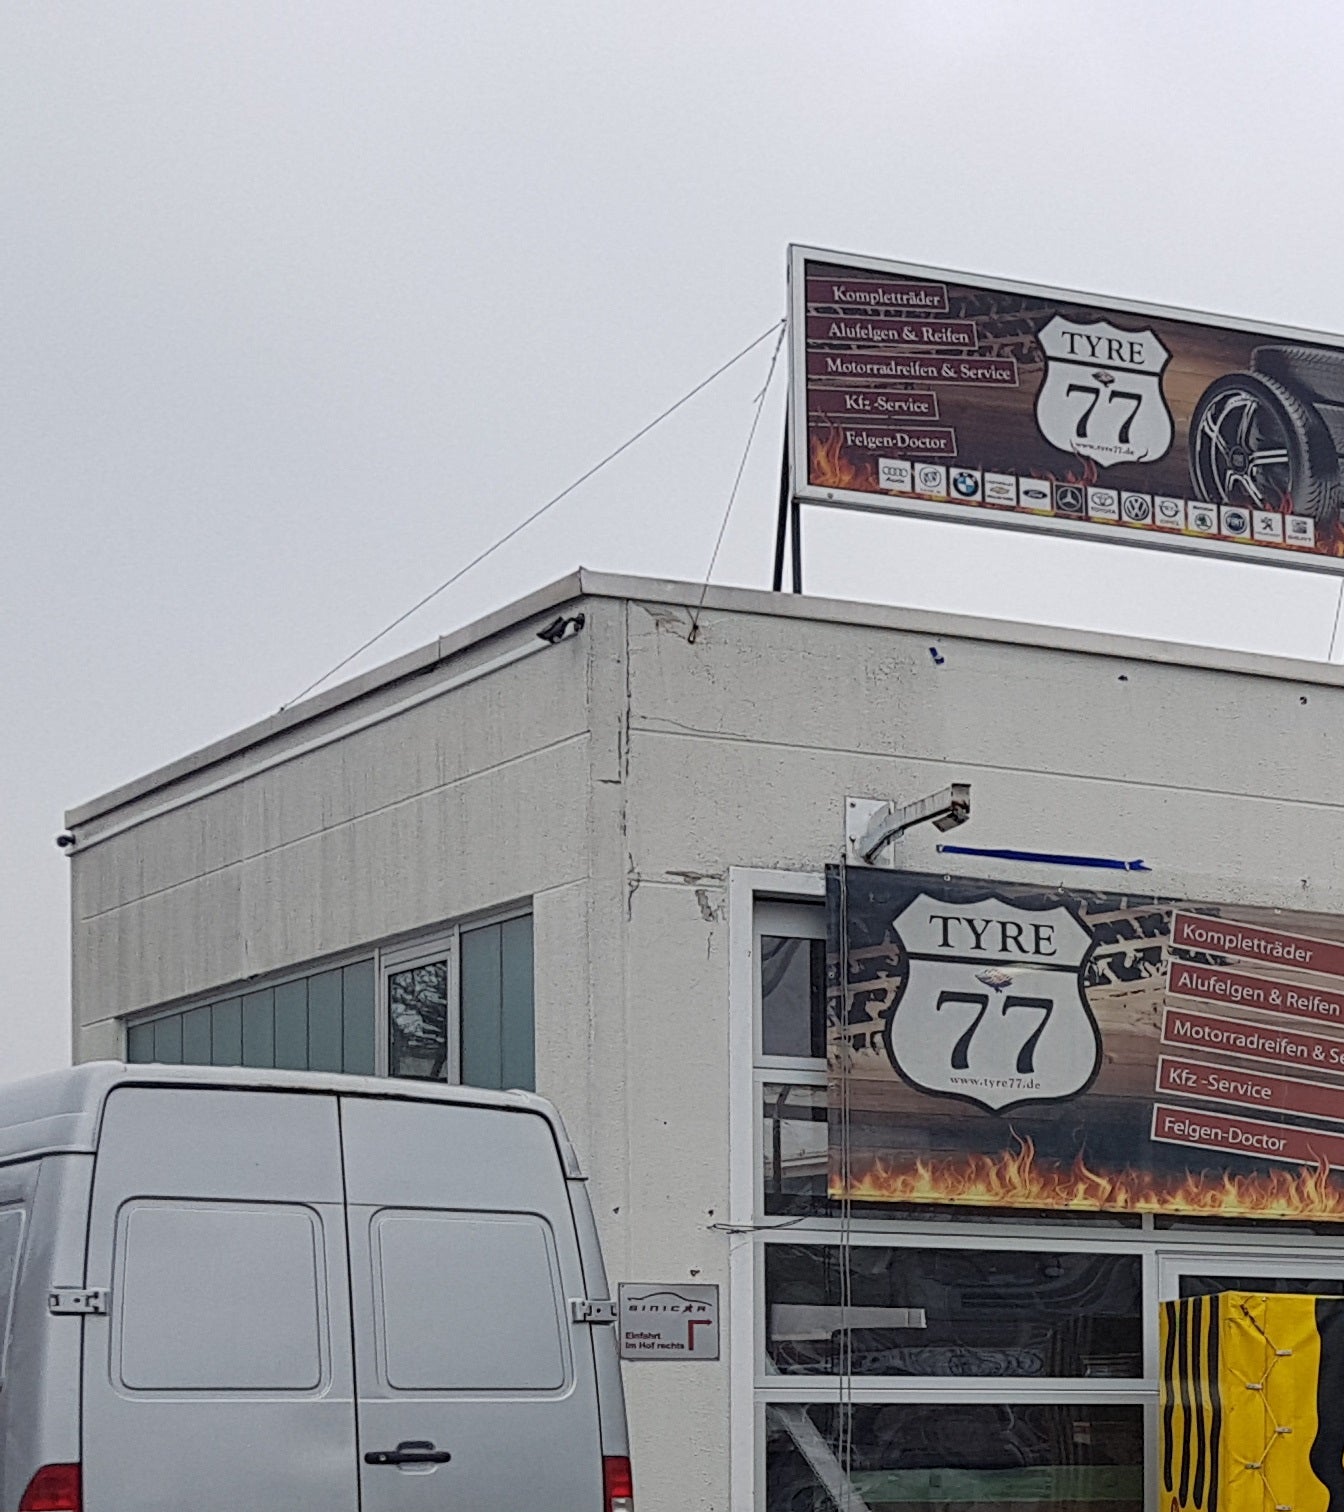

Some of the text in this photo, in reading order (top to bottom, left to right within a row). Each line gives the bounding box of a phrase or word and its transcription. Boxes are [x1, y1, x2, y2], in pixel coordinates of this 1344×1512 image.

[833, 286, 940, 306] Kompletträder
[829, 322, 969, 343] Alufelgen & Reifen
[1061, 331, 1145, 365] TYRE
[826, 358, 1011, 380] Motorradreifen & Service
[845, 394, 872, 411] Kfz
[1066, 383, 1142, 444] 77
[846, 431, 947, 449] Felgen-Doctor
[929, 914, 1058, 957] TYRE
[1183, 923, 1313, 963] Kompletträder
[1177, 971, 1341, 1017] Alufelgen & Reifen
[936, 990, 1054, 1075] 77
[1173, 1019, 1308, 1058] Motorradreifen
[1311, 1044, 1326, 1061] &
[949, 1075, 1041, 1090] www.tyre77.de
[1168, 1067, 1198, 1085] Kfz
[1163, 1116, 1287, 1151] Felgen-Doctor
